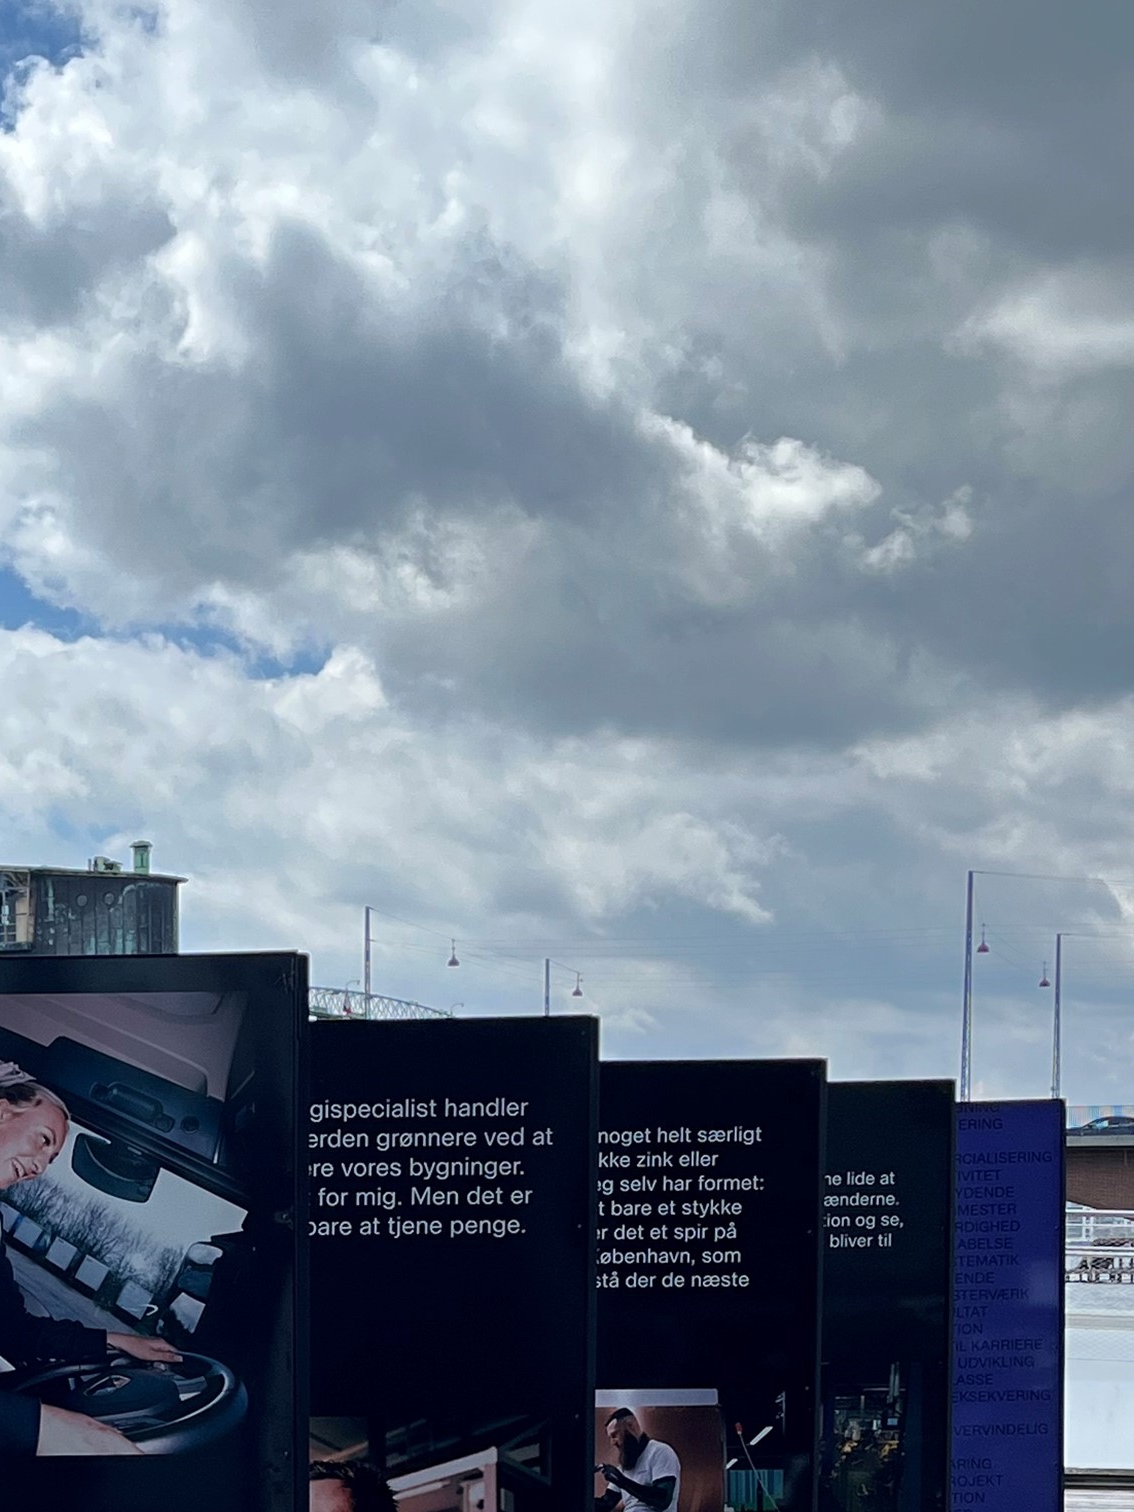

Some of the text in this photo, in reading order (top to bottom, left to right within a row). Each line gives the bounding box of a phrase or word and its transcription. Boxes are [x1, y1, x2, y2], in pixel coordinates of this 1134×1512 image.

[309, 1097, 529, 1123] gispecialist handler
[958, 1118, 1003, 1130] ERING
[376, 1131, 477, 1152] grønnere
[483, 1126, 525, 1147] ved
[532, 1127, 554, 1146] at
[597, 1125, 763, 1147] noget helt særligt
[636, 1151, 674, 1168] zink
[678, 1150, 719, 1167] eller
[308, 1156, 525, 1181] re vores bygninger.
[619, 1175, 658, 1192] selv
[662, 1175, 693, 1192] har
[697, 1174, 764, 1192] formet:
[846, 1171, 876, 1186] lide
[879, 1171, 896, 1186] at
[317, 1185, 533, 1210] for mig. Men det er
[823, 1192, 900, 1207] ænderne.
[610, 1199, 652, 1217] bare
[657, 1200, 676, 1216] et
[681, 1198, 743, 1219] stykke
[957, 1203, 1017, 1216] MESTER
[359, 1217, 381, 1236] at
[387, 1216, 443, 1239] tjene
[450, 1219, 526, 1238] penge.
[854, 1215, 876, 1230] og
[881, 1216, 903, 1228] se,
[613, 1223, 645, 1241] det
[649, 1224, 668, 1240] et
[673, 1223, 709, 1243] spir
[713, 1221, 737, 1243] på
[829, 1232, 892, 1249] bliver til
[957, 1237, 1013, 1250] ABELSE
[596, 1247, 741, 1266] øbenhavn, som
[954, 1254, 1020, 1267] TEMATIK
[625, 1271, 657, 1289] der
[661, 1271, 685, 1288] de
[691, 1271, 750, 1288] næste
[954, 1305, 988, 1318] LTAT
[971, 1339, 1043, 1351] KARRIERE
[958, 1356, 1035, 1369] UDVIKLING
[953, 1373, 993, 1386] ASSE
